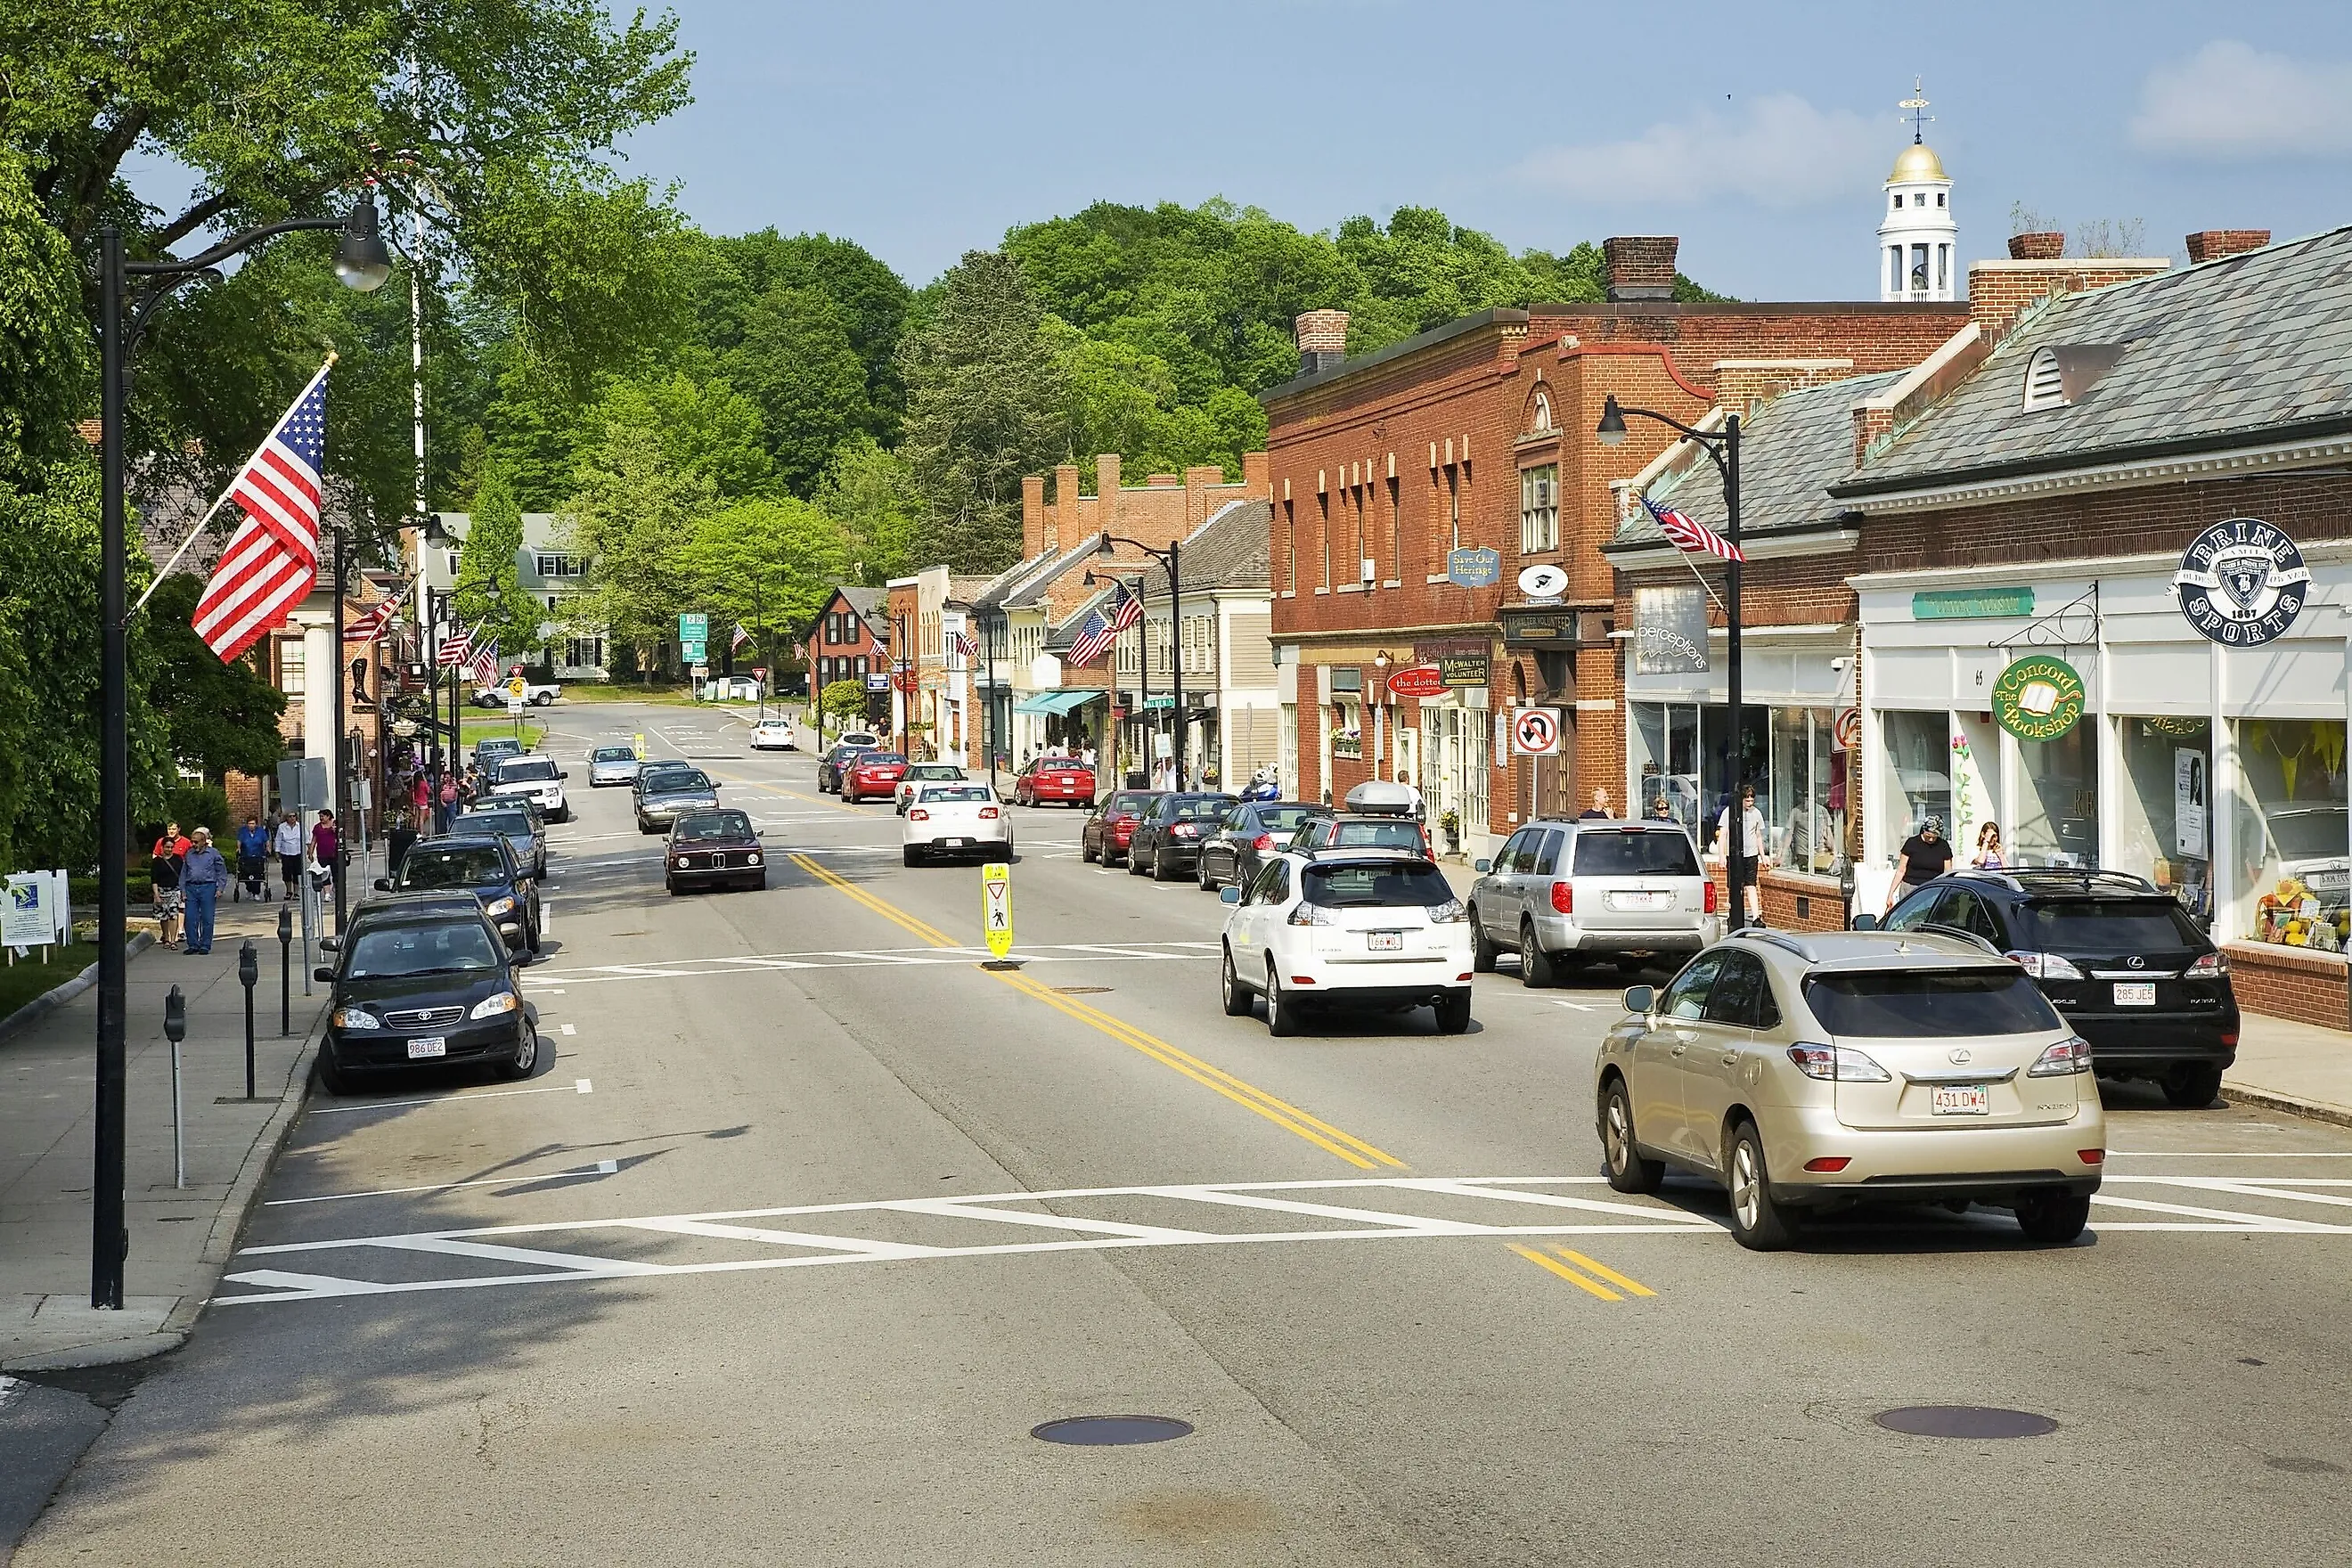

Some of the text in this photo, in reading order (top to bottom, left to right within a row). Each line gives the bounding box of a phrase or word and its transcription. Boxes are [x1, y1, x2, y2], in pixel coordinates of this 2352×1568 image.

[2192, 523, 2295, 566] BRINE
[1454, 553, 1495, 564] Save Our
[1455, 565, 1492, 576] Heritage
[2189, 593, 2300, 644] SPORTS
[1637, 625, 1707, 669] perceptions
[1418, 657, 1428, 665] 55
[1445, 667, 1486, 678] VOLUNTEER
[1975, 669, 1983, 686] 65
[2003, 664, 2078, 691] Concord
[1396, 676, 1411, 687] the
[1996, 690, 2018, 701] The
[2003, 702, 2081, 738] Bookshop
[2116, 989, 2153, 1000] 285 JE5
[409, 1041, 443, 1055] 986 DE2
[1936, 1092, 1986, 1107] 431 DW4
